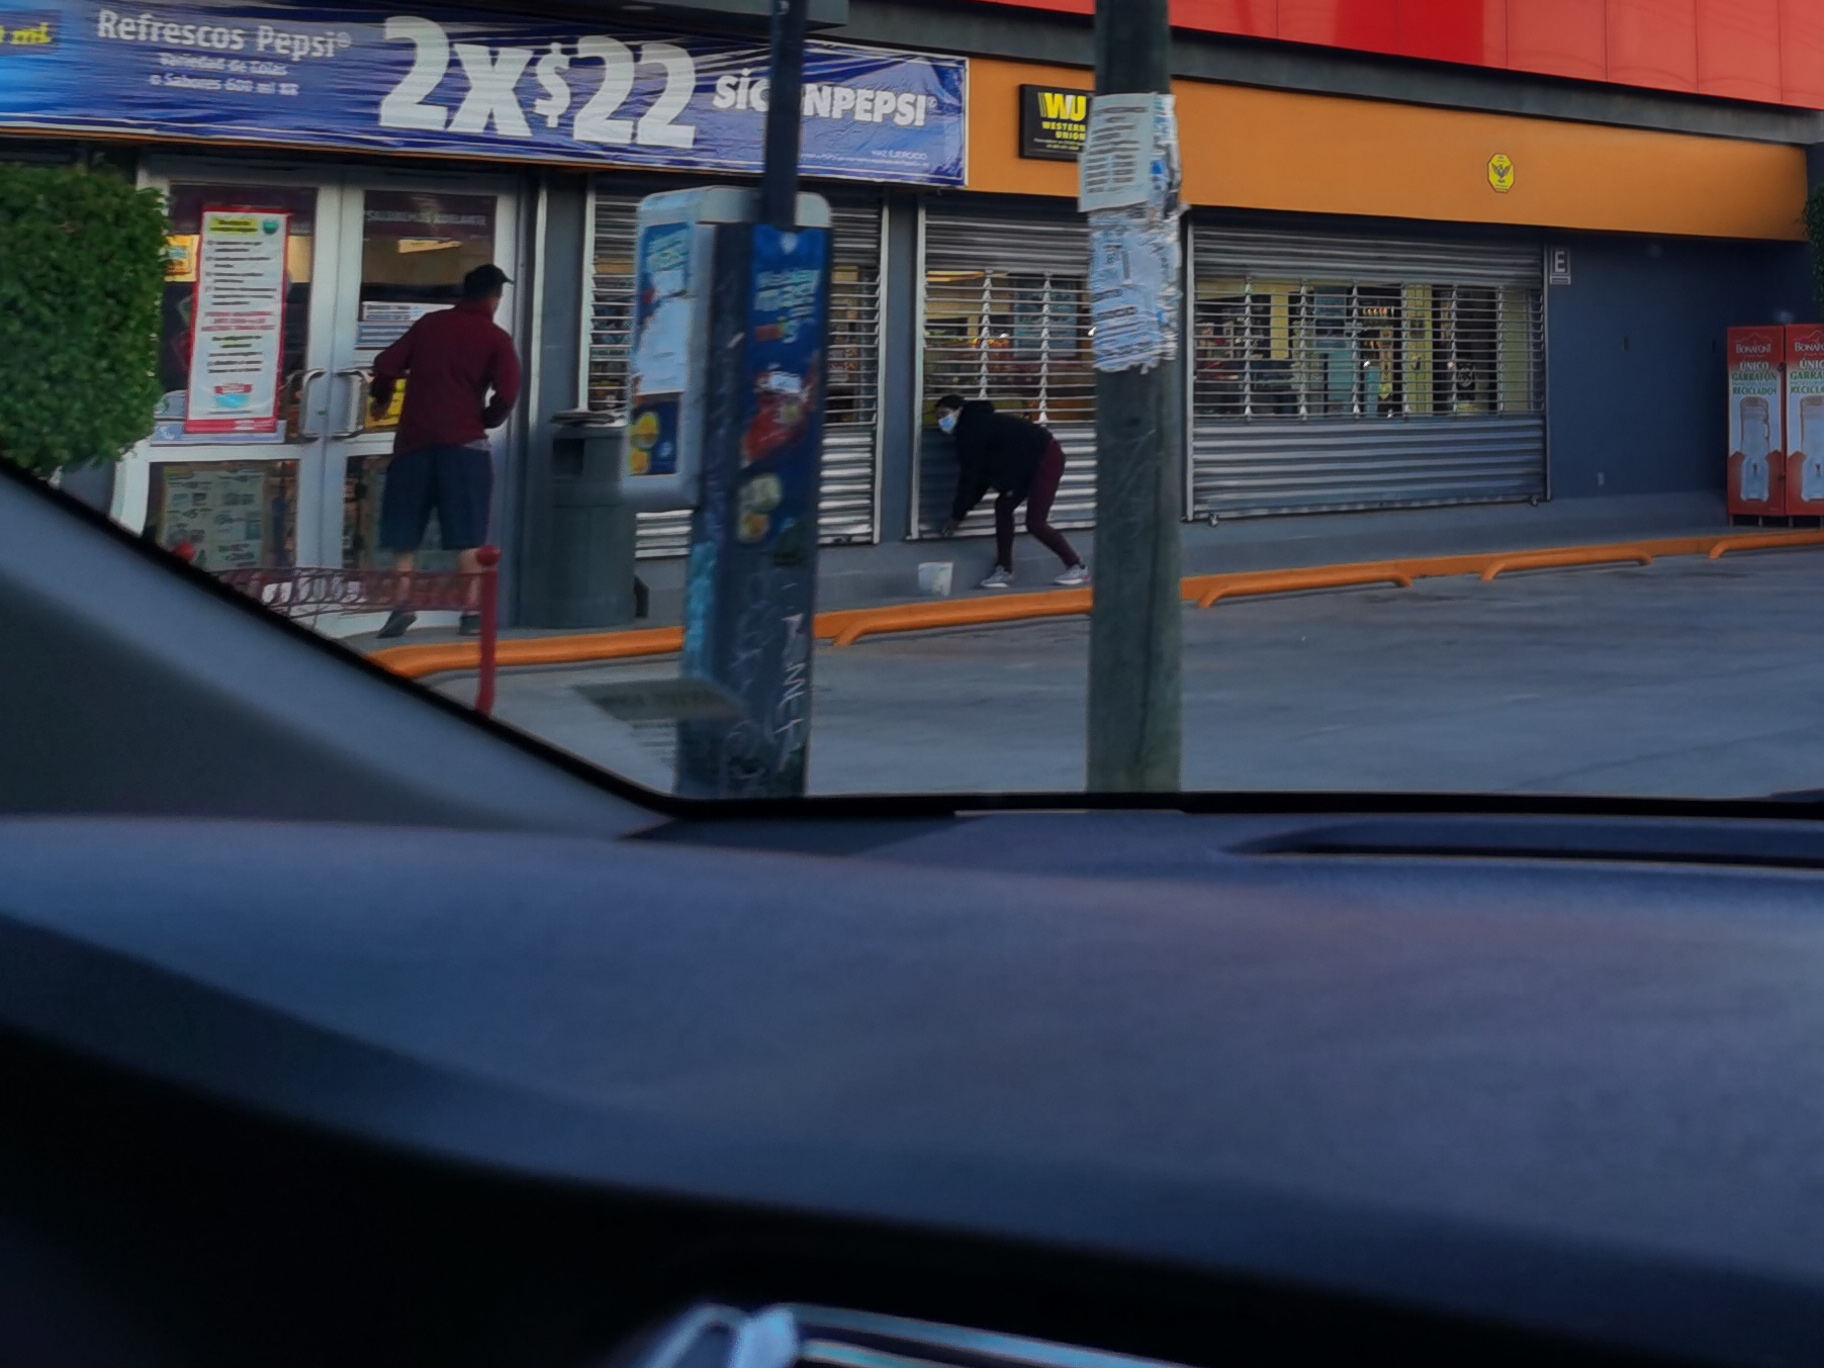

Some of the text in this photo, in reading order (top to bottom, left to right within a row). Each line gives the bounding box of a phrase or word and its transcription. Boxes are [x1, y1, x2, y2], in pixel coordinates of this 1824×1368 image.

[97, 9, 246, 51] Refrescos
[1038, 92, 1087, 122] WU
[1042, 121, 1086, 132] WESTERN
[1055, 131, 1086, 140] UNION
